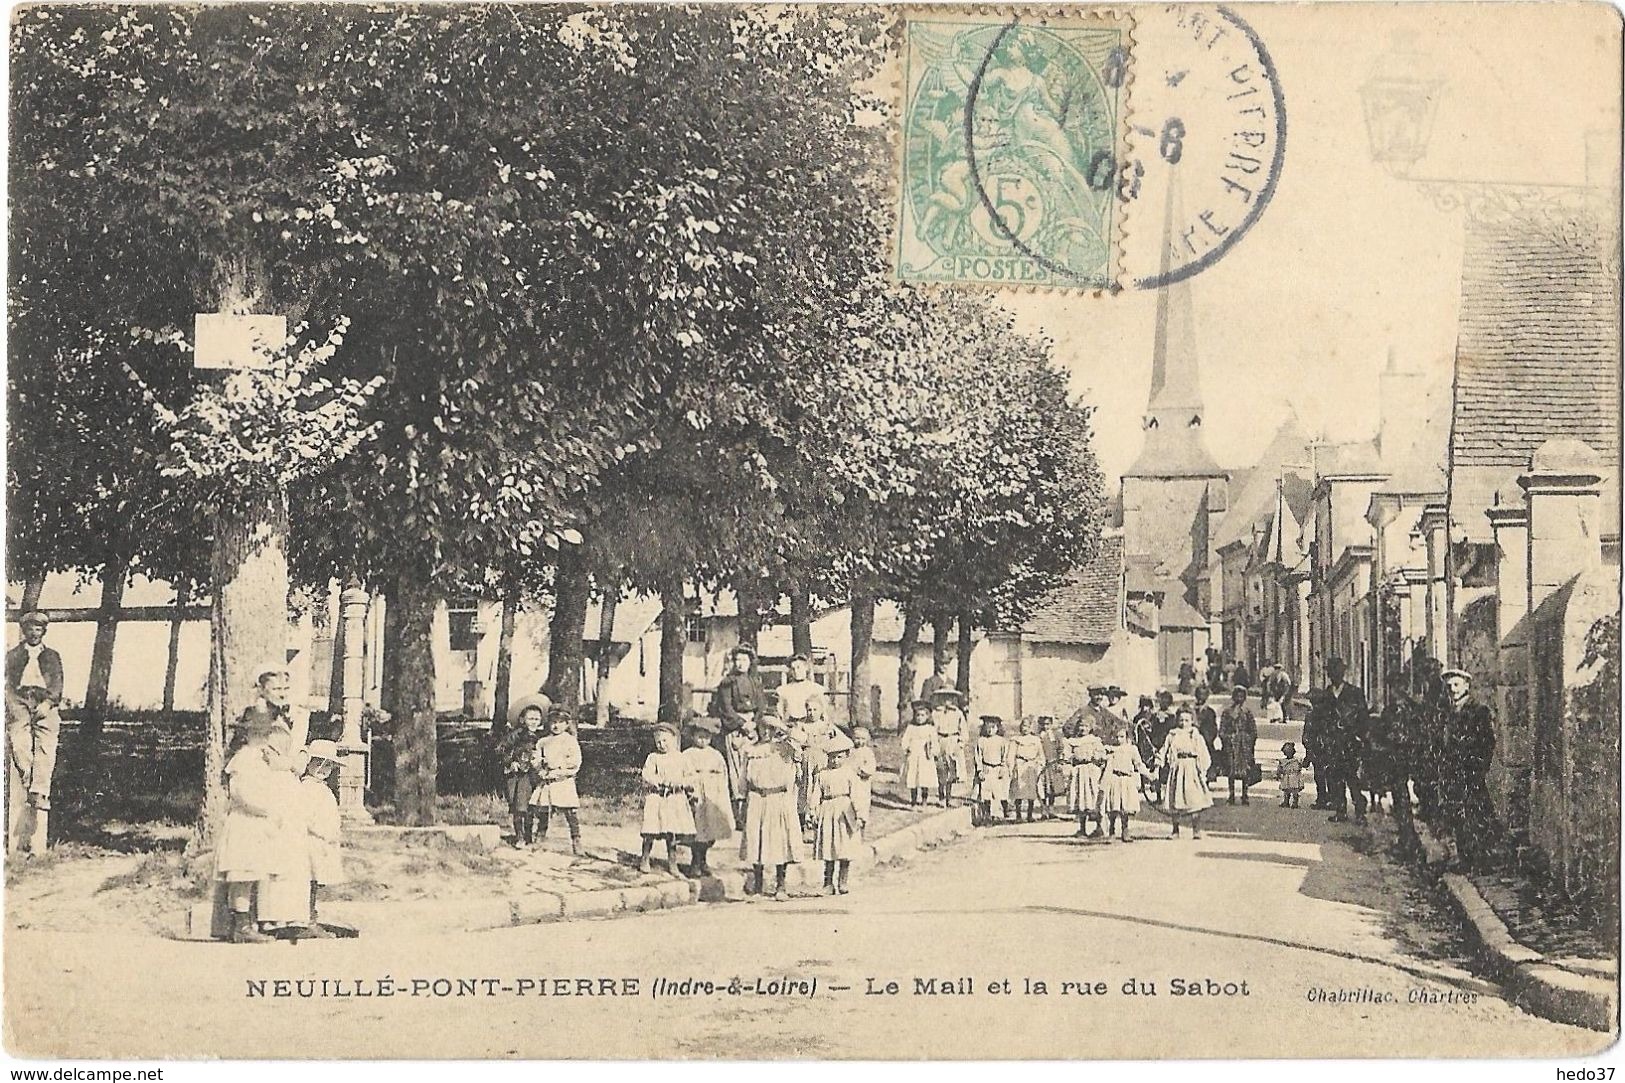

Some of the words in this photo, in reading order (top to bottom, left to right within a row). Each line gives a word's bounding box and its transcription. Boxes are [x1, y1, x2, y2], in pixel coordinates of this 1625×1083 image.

[958, 257, 1048, 281] POSTES
[245, 974, 641, 998] NEUILLÉ-PONT-PIERRE
[652, 975, 818, 1000] (Indre-&-Loire)
[865, 977, 900, 996] Le
[913, 977, 974, 996] Mail
[986, 978, 1013, 996] et
[1023, 977, 1049, 996] la
[1060, 982, 1108, 996] rue
[1121, 977, 1157, 996] du
[1170, 977, 1251, 997] Sabot
[1408, 987, 1478, 1004] Chartres
